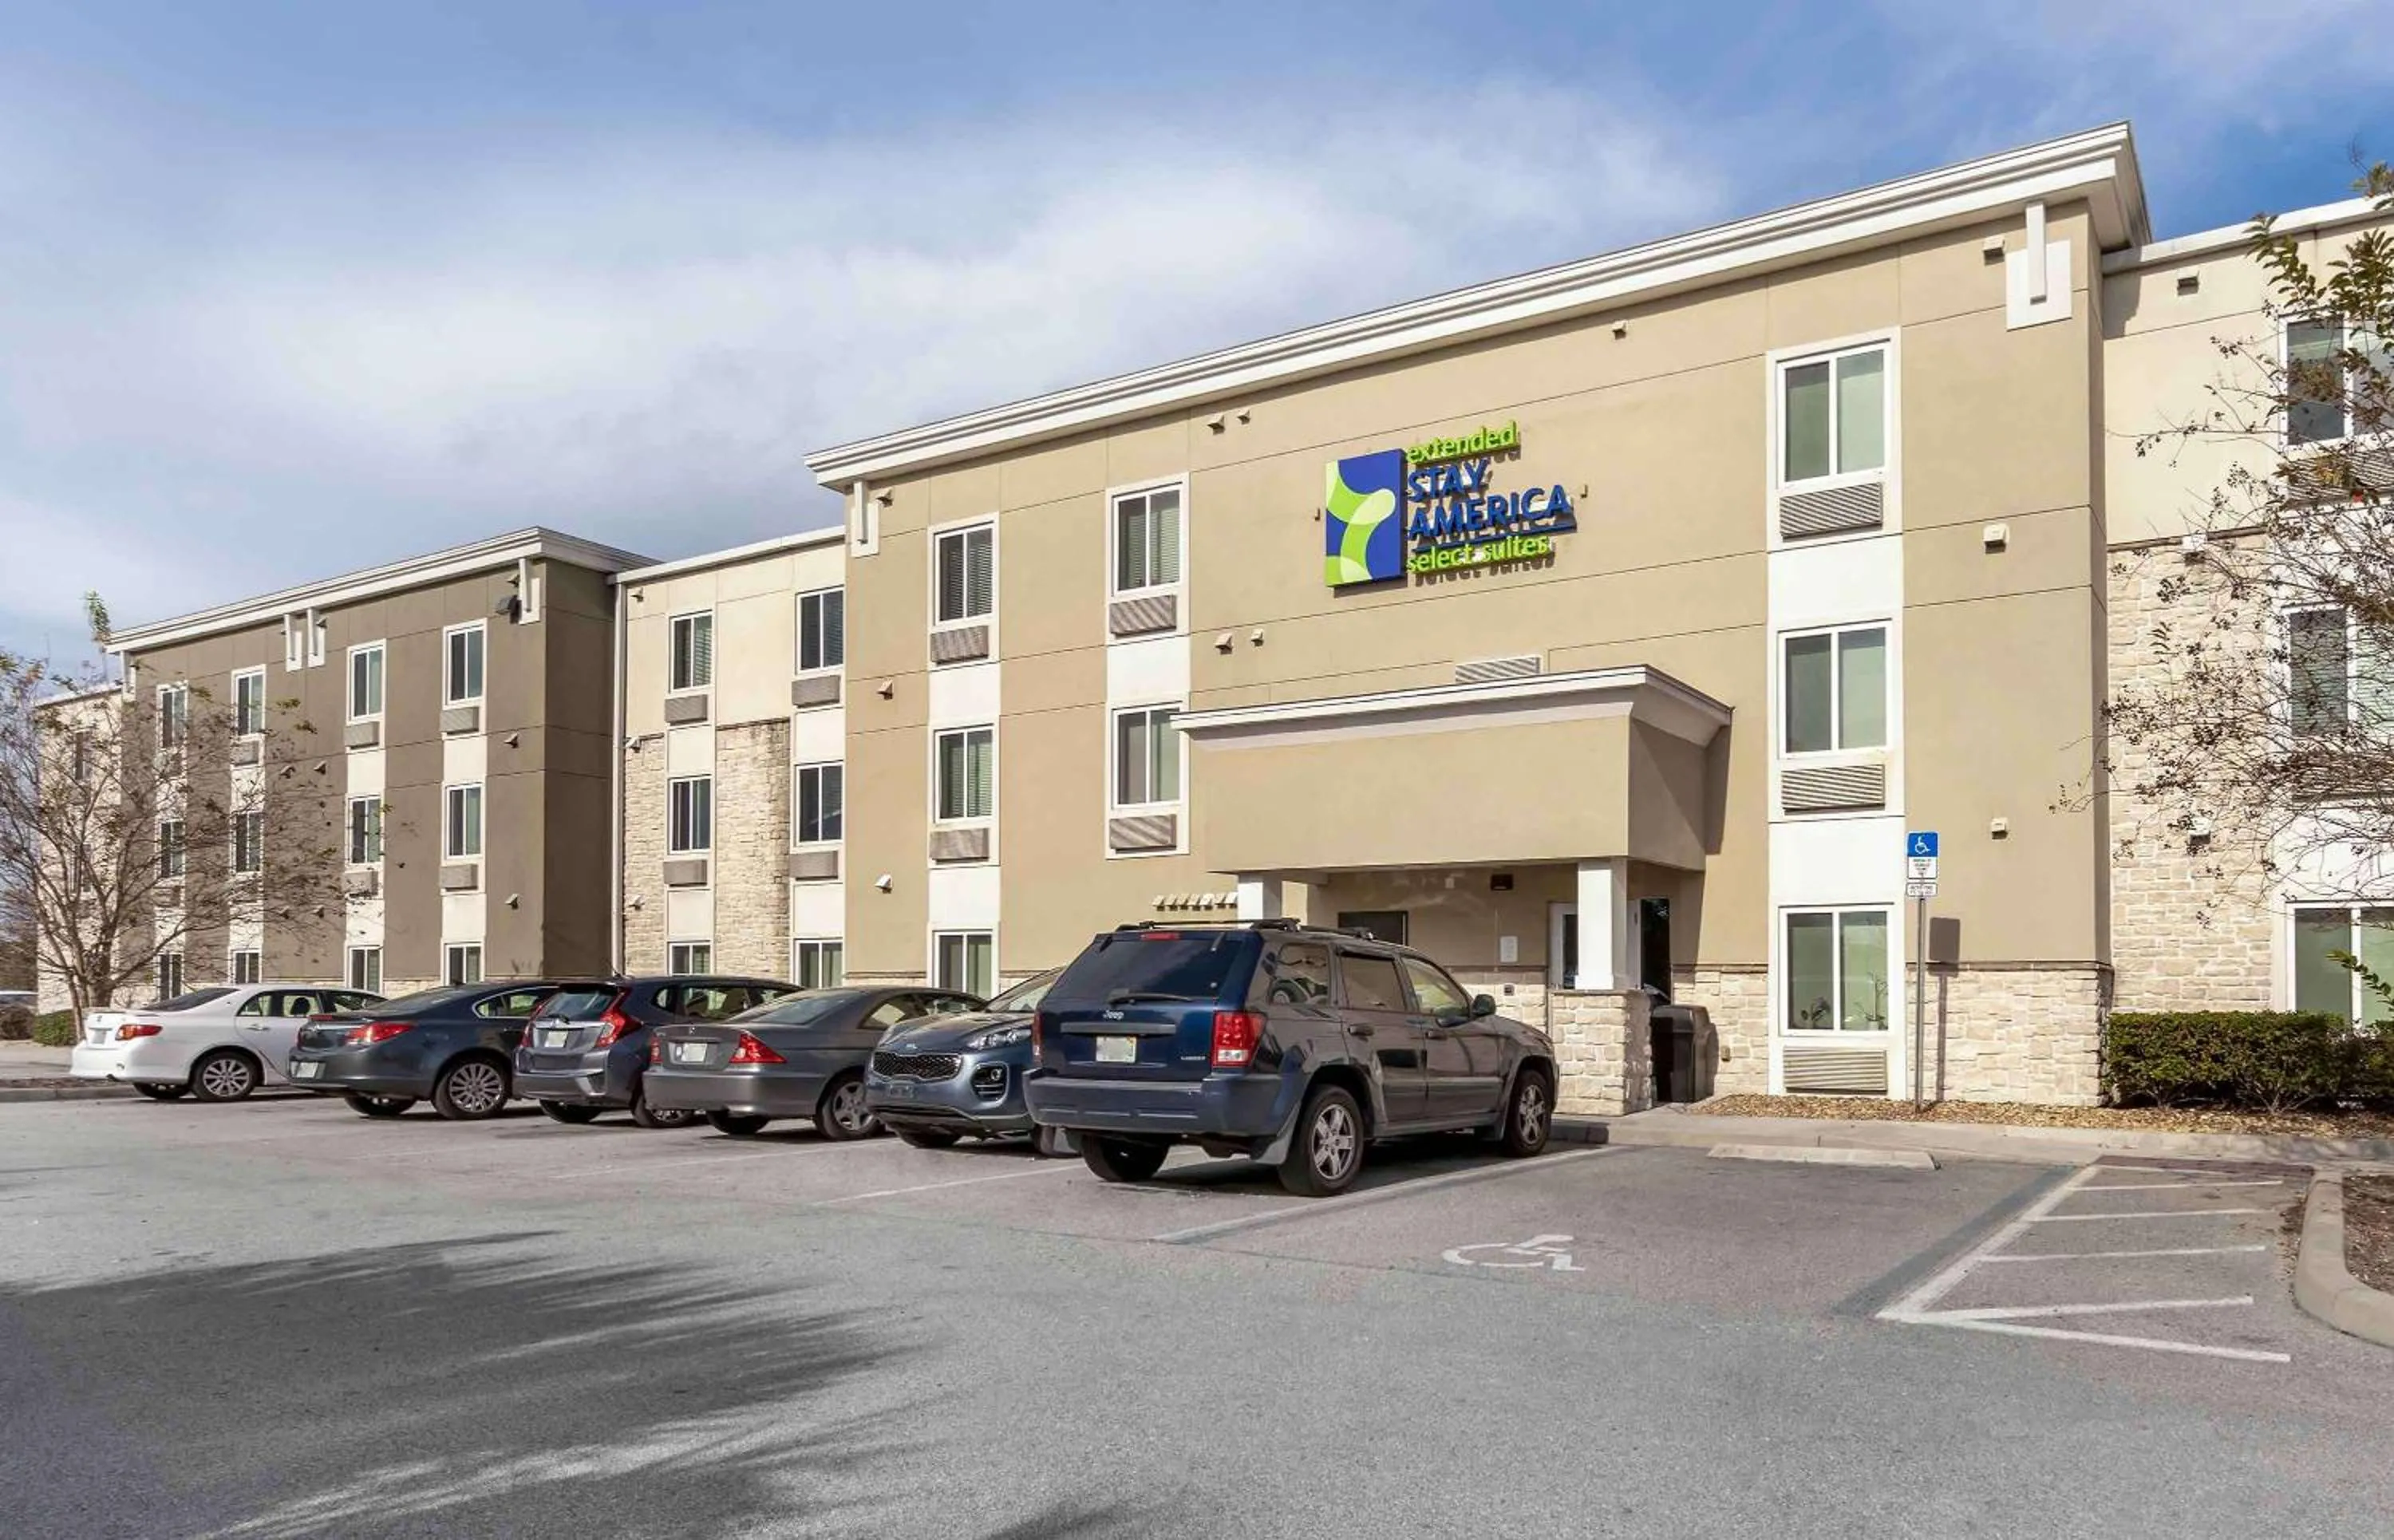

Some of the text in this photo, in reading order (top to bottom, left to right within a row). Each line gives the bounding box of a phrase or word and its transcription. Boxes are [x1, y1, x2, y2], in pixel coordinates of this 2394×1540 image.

[1406, 421, 1518, 464] extended
[1407, 457, 1491, 503] STAY
[1407, 484, 1570, 540] AMERICA
[1407, 535, 1551, 572] select suites
